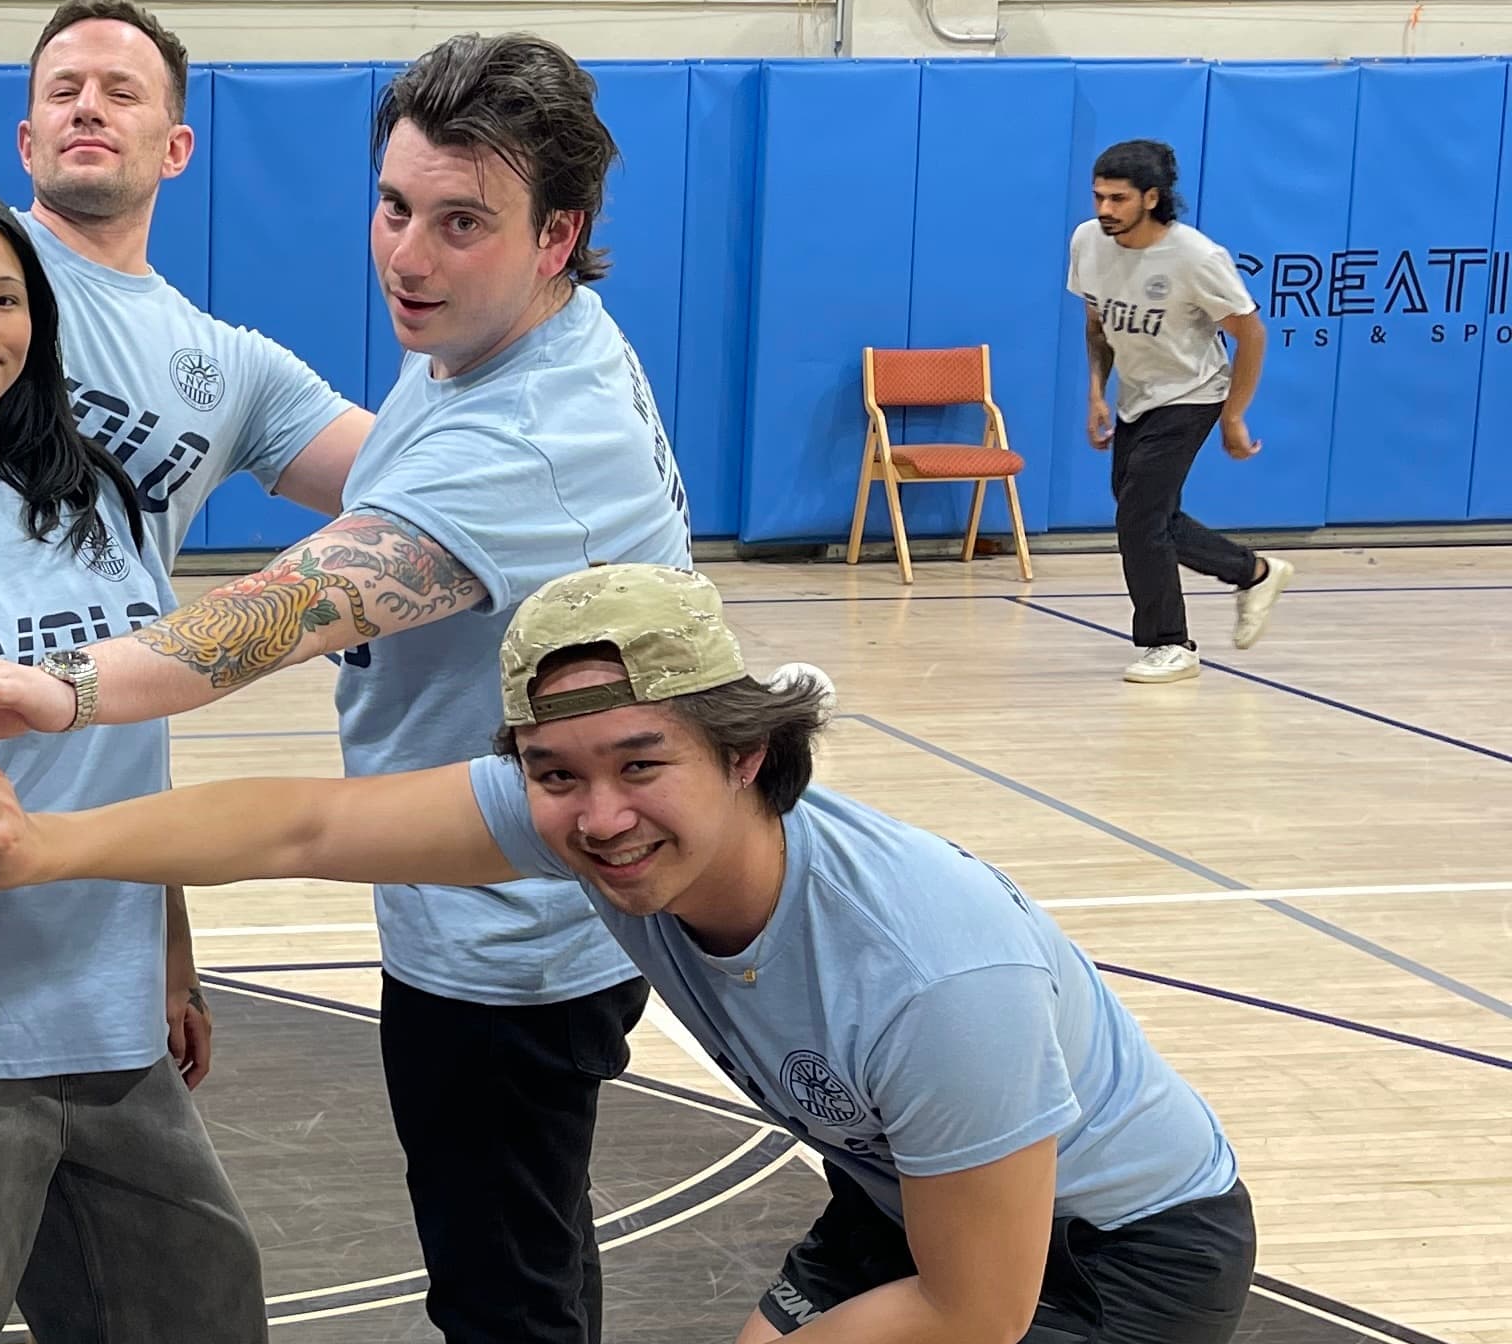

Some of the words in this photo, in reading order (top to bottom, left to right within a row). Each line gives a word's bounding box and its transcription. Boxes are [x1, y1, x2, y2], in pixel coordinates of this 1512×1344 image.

[1370, 325, 1387, 344] &
[185, 373, 213, 394] NYC
[804, 1085, 844, 1112] NYC
